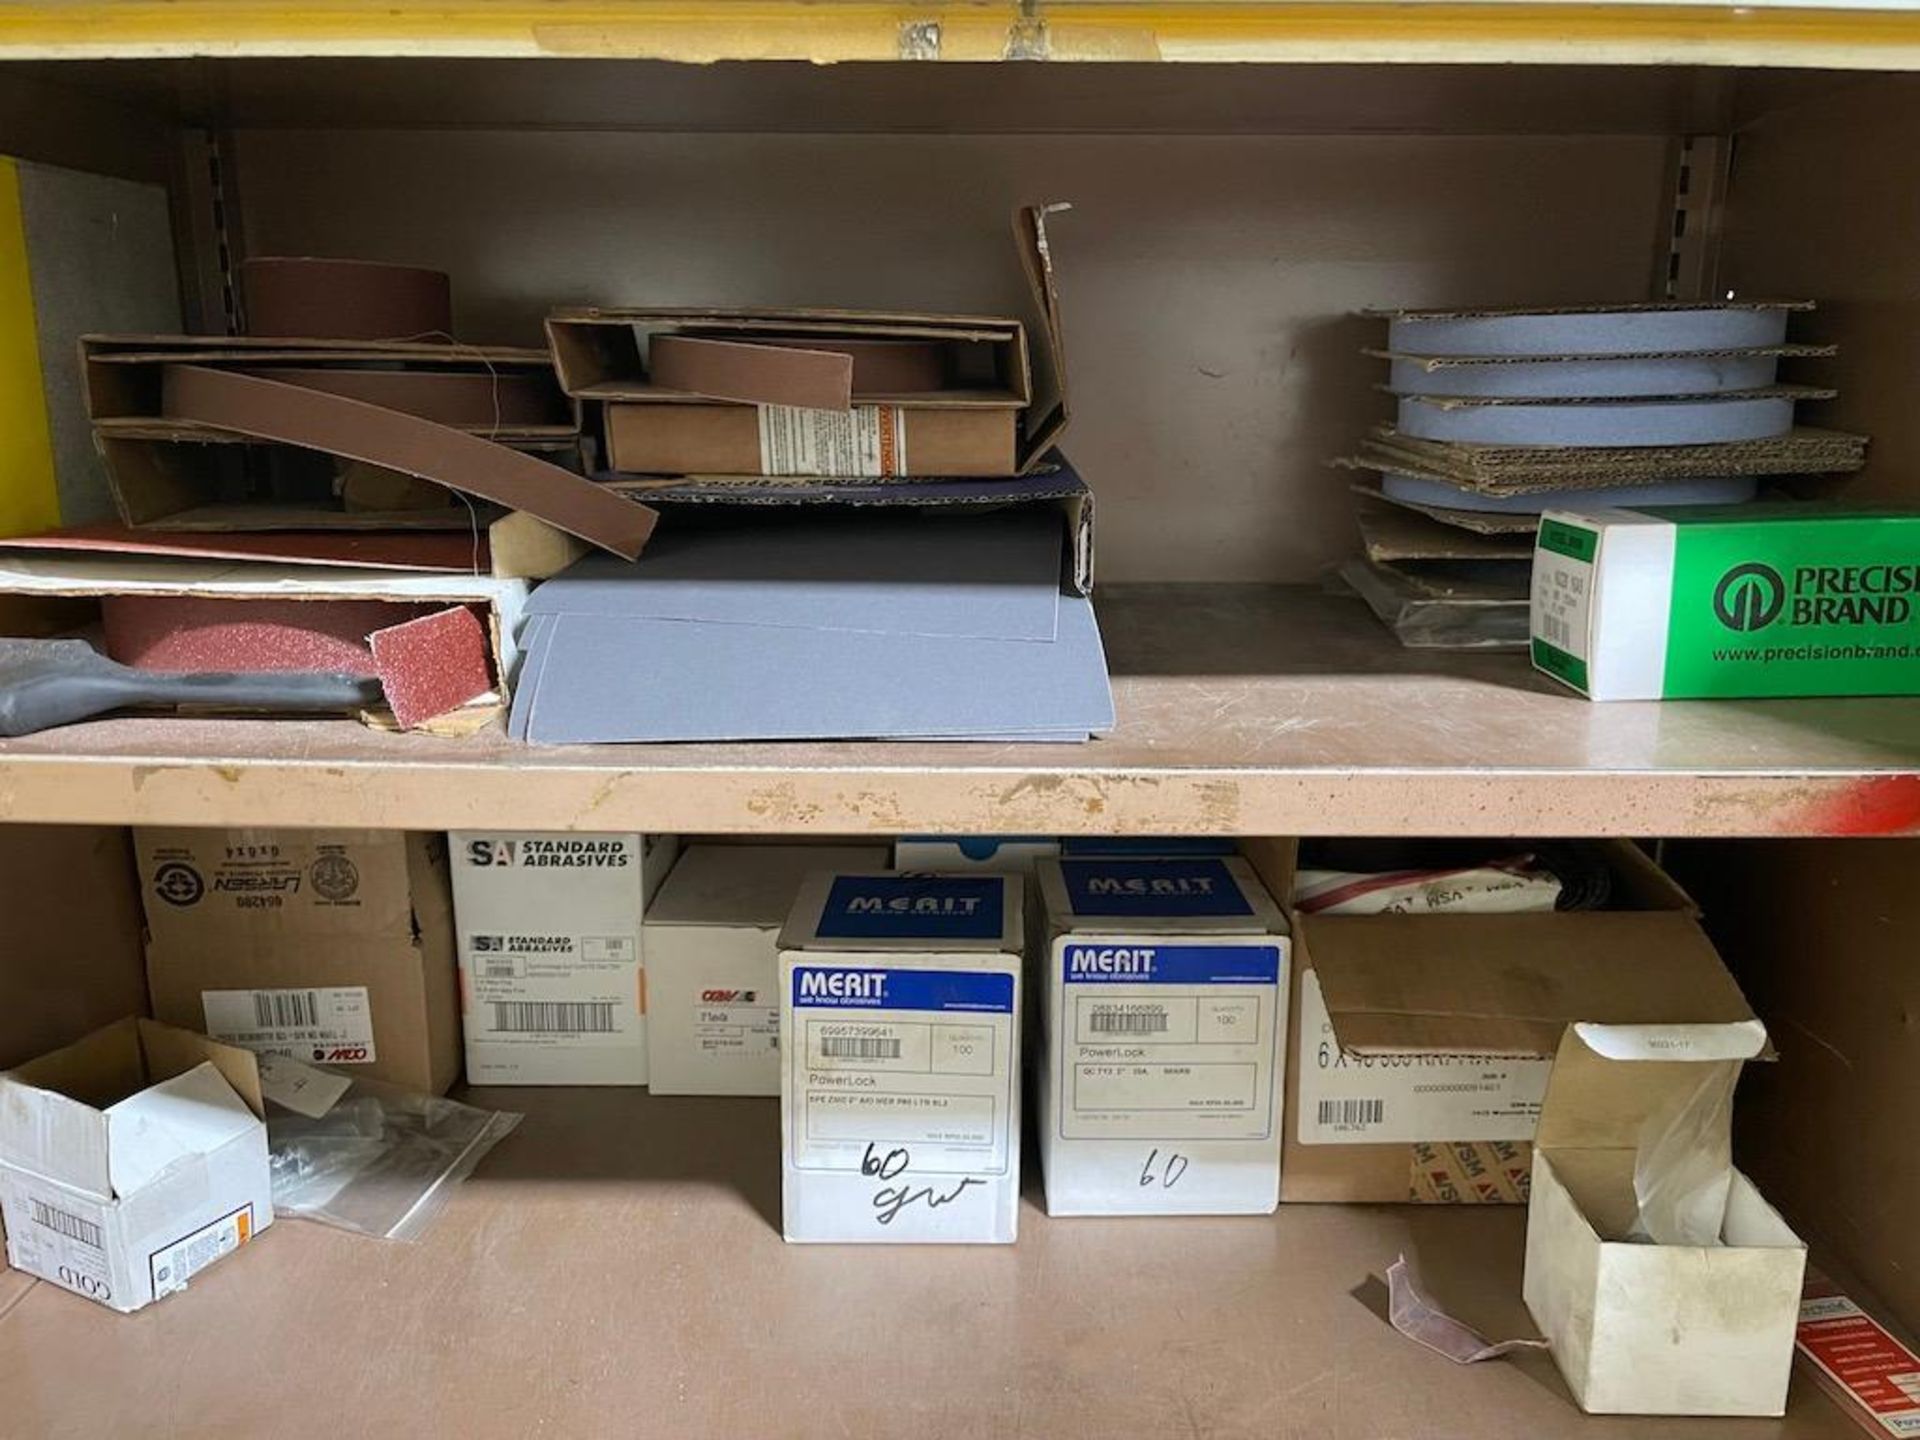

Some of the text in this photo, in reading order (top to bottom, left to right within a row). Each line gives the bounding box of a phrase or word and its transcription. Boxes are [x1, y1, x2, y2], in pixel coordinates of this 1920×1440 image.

[1791, 597, 1910, 625] BRAND
[522, 841, 624, 854] STANDARD
[523, 855, 629, 867] ABRASIVES
[214, 877, 300, 893] LARSEN
[1088, 877, 1214, 892] MERIT
[846, 897, 981, 911] MERIT
[508, 936, 571, 945] STANDARD
[1070, 948, 1156, 973] MERIT
[800, 971, 887, 997] MERIT
[1079, 1047, 1146, 1058] PowerLock
[1318, 1042, 1330, 1068] 6
[809, 1073, 876, 1087] PowerLock
[861, 1141, 909, 1180] 60
[1139, 1148, 1188, 1189] 60
